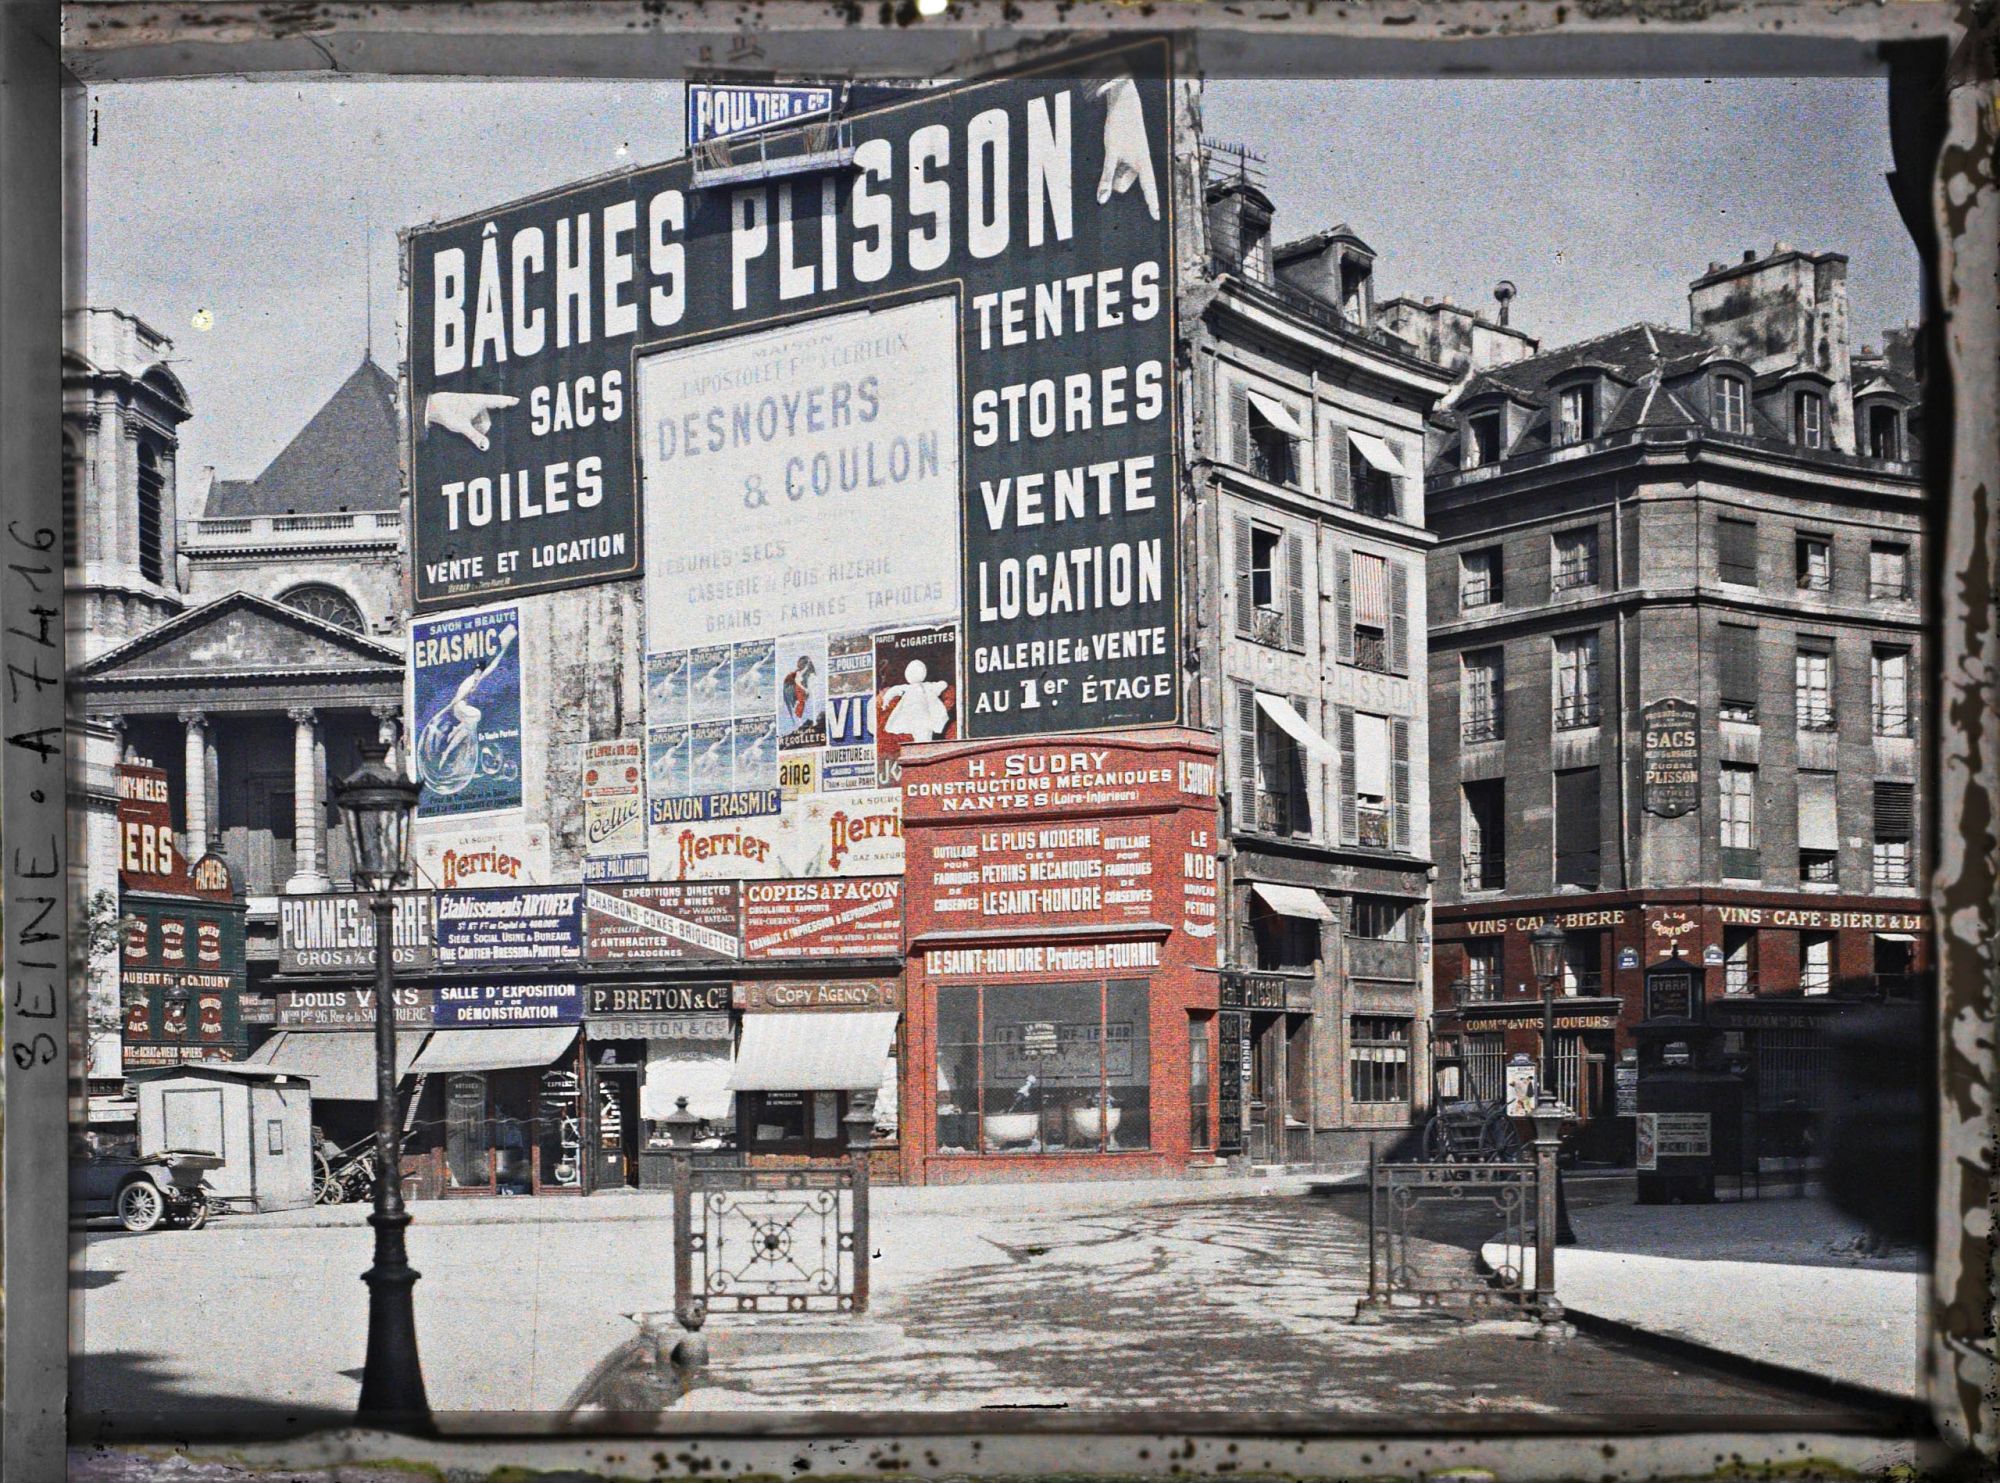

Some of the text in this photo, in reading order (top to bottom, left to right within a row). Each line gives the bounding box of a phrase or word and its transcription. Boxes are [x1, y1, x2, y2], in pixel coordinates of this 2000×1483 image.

[697, 91, 789, 139] POULTIER
[434, 90, 1073, 376] BÂCHES PLISSON
[973, 261, 1160, 350] TENTES
[530, 369, 622, 437] SACS
[973, 360, 1163, 447] STORES
[657, 375, 880, 462] DESNOYERS
[743, 429, 939, 509] & COULON
[441, 456, 603, 531] TOILES
[980, 455, 1156, 530] VENTE
[426, 533, 625, 584] VENTE ET LOCATION
[829, 557, 892, 582] RIZERIE
[978, 538, 1162, 622] LOCATION
[706, 581, 942, 633] GRAINS FARINES TAPIOCAS
[430, 611, 517, 636] SAVON BEAUTÉ
[415, 628, 498, 669] ERASMIC
[900, 632, 955, 648] CIGARETTES
[974, 627, 1165, 673] GALERIE de VENTE
[836, 653, 872, 672] POULTIER
[974, 690, 1010, 714] AU
[1081, 673, 1171, 704] ÉTAGE
[1646, 731, 1696, 749] SACS
[825, 747, 862, 764] OUVERTURE
[968, 752, 1109, 778] H. SUDRY
[779, 761, 811, 785] aine
[907, 769, 1172, 797] CONSTRUCTIONS MÉCANIQUES
[1645, 770, 1699, 785] PLISSON
[653, 790, 777, 822] SAVON ERASMIC
[942, 793, 1049, 811] NANTES
[981, 828, 1100, 852] LE PLUS MODERNE
[1104, 835, 1151, 850] OUTILLAGE
[1191, 830, 1207, 848] LE
[933, 845, 979, 859] OUTILLAGE
[1026, 851, 1054, 860] DES
[1116, 852, 1140, 860] POUR
[195, 859, 227, 890] PAPIERS
[944, 861, 969, 869] POUR
[1104, 862, 1152, 876] FABRIQUES
[1184, 852, 1215, 880] NOB
[622, 885, 731, 898] EXPÉDITIONS DIRECTES
[749, 881, 900, 902] COPIES à FAÇON
[948, 888, 961, 896] DE
[1121, 879, 1135, 887] DE
[439, 893, 580, 920] Établissements ARTOFEX
[659, 897, 714, 906] DES MINES
[692, 906, 727, 915] WAGONS
[983, 891, 998, 916] LE
[999, 884, 1102, 915] SAINT-HONORÉ
[281, 898, 373, 949] POMMES de
[590, 892, 736, 955] CHARBONS COKES BRIQUETTES
[1467, 919, 1507, 935] VINS
[1718, 906, 1761, 924] VINS
[1773, 909, 1821, 927] CAFÉ
[1830, 911, 1886, 929] BIÈRE
[1889, 915, 1900, 929] &
[502, 931, 525, 942] USINE
[533, 931, 571, 942] BUREAUX
[591, 936, 668, 948] d'ANTHRACITES
[297, 950, 342, 966] GROS
[440, 947, 457, 960] RUE
[926, 951, 941, 975] LE
[1106, 942, 1160, 969] FOURNIL
[122, 971, 160, 984] AUBERT
[199, 975, 231, 988] TOURY
[1651, 979, 1688, 992] BYRRH
[441, 984, 576, 999] SALLE D'EXPOSITION
[593, 988, 705, 1012] P. BRETON &
[818, 985, 870, 1002] AGENCY
[457, 1005, 558, 1021] DÉMONSTRATION
[1507, 1020, 1518, 1030] de
[1518, 1017, 1544, 1029] VINS
[128, 1021, 148, 1032] SACS
[610, 1021, 683, 1035] BRETON
